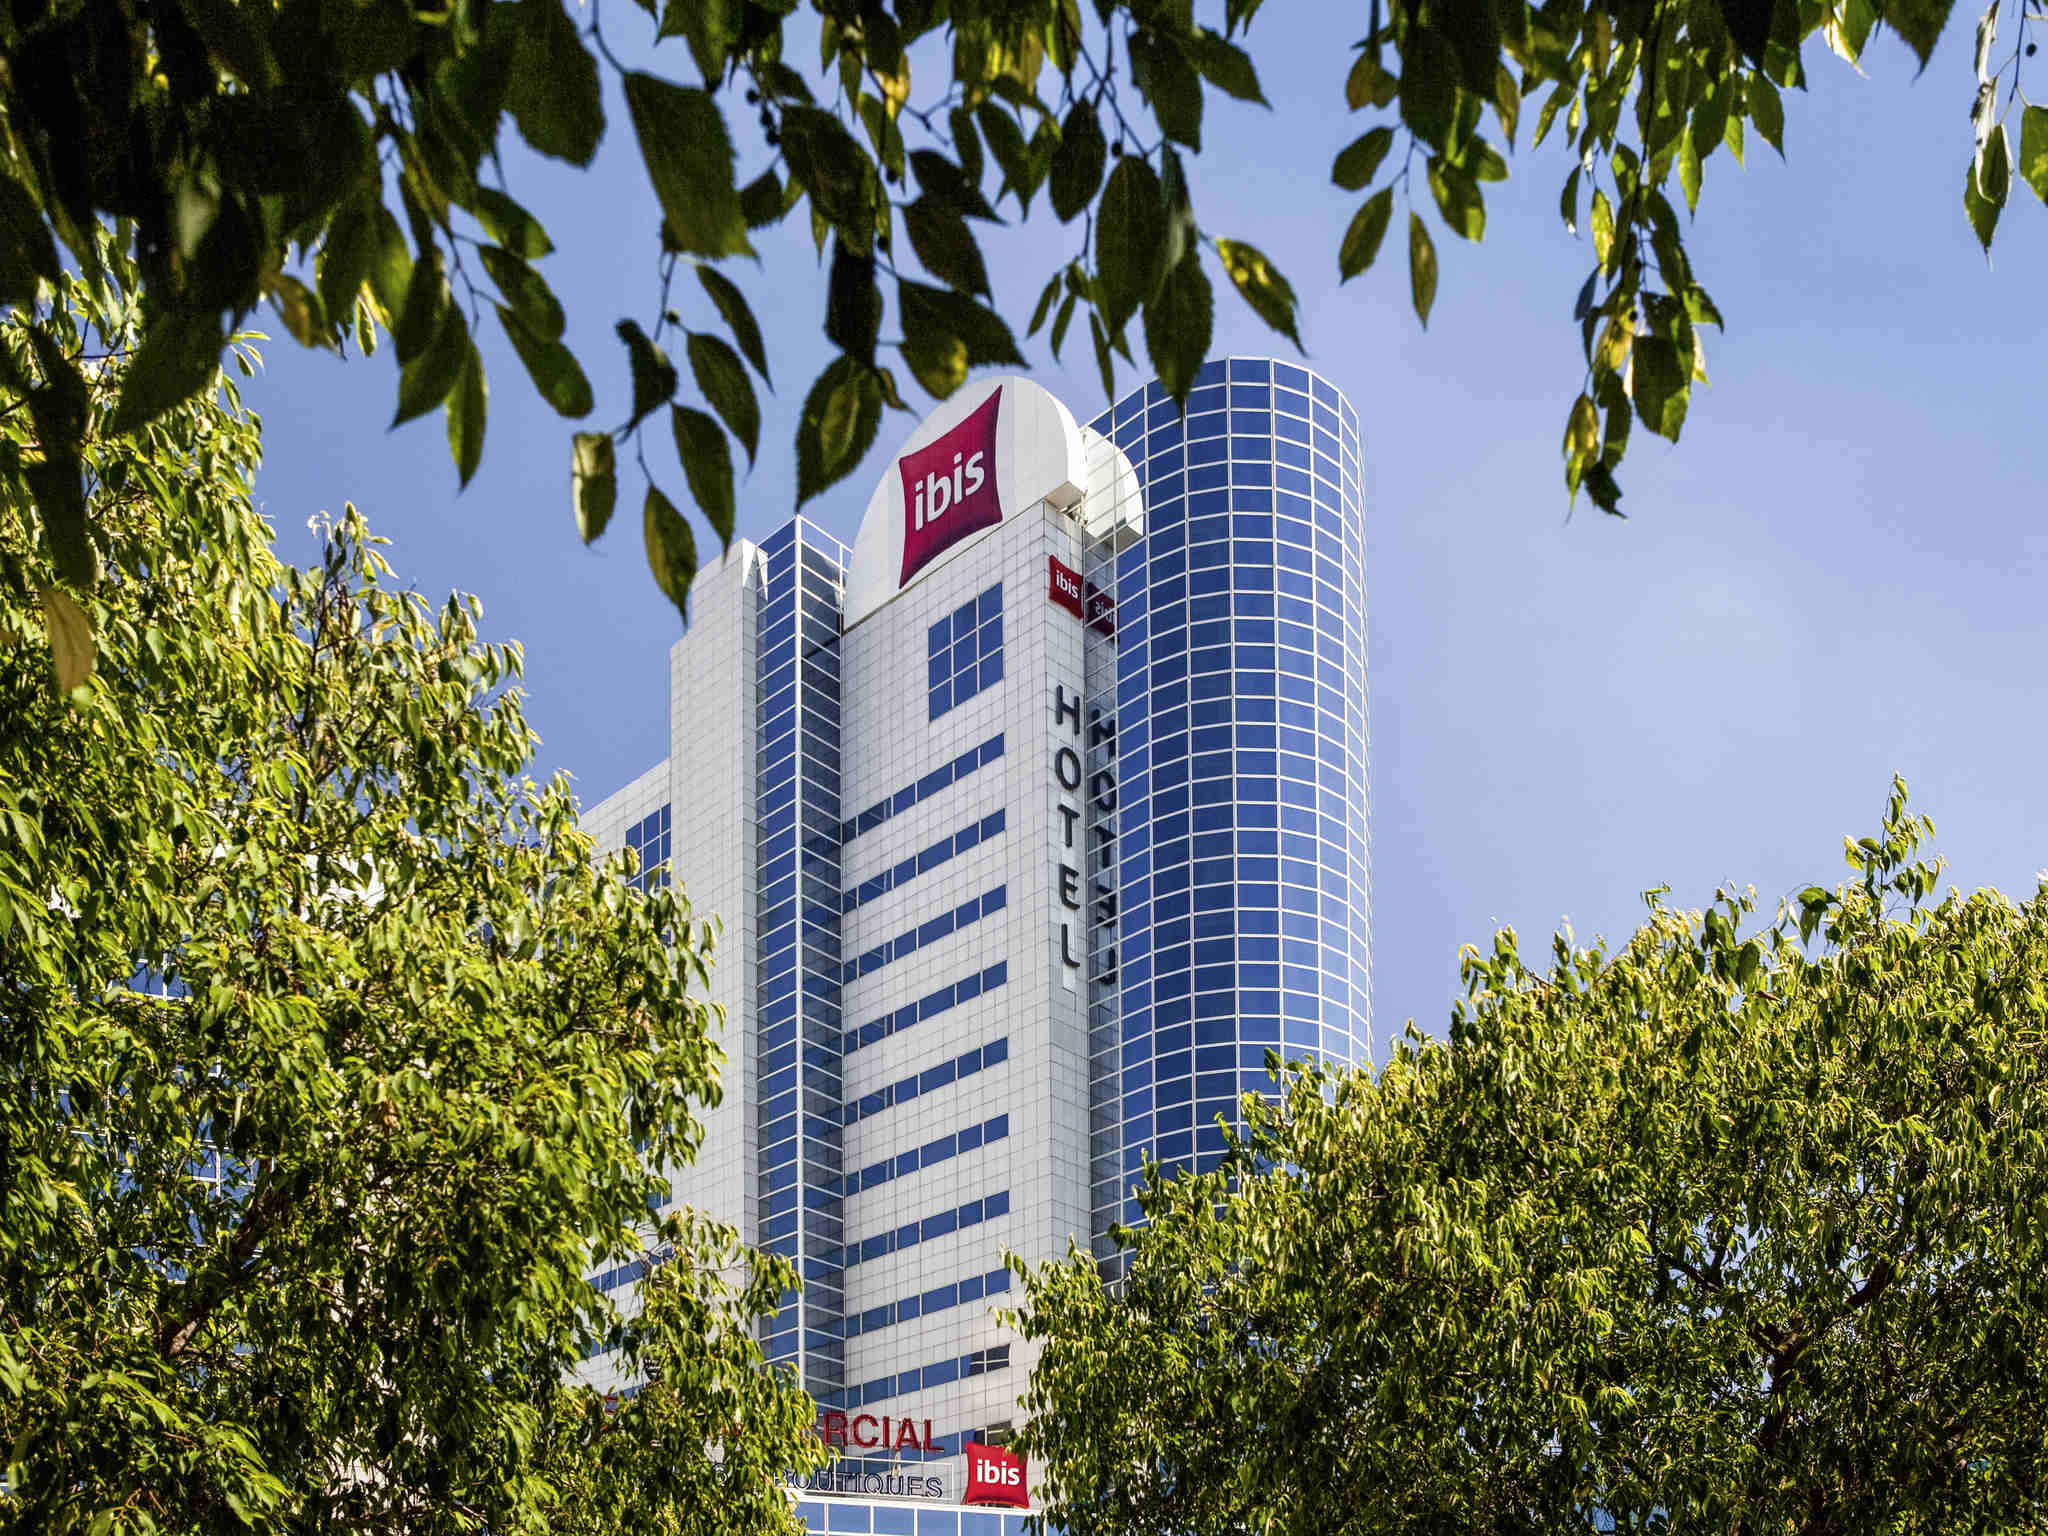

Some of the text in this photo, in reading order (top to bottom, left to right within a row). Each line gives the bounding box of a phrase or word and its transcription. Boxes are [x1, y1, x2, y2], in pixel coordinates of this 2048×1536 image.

[914, 450, 985, 531] ibis
[1056, 570, 1079, 599] ibis
[1055, 684, 1081, 968] HOTEL
[976, 1459, 1020, 1486] ibis
